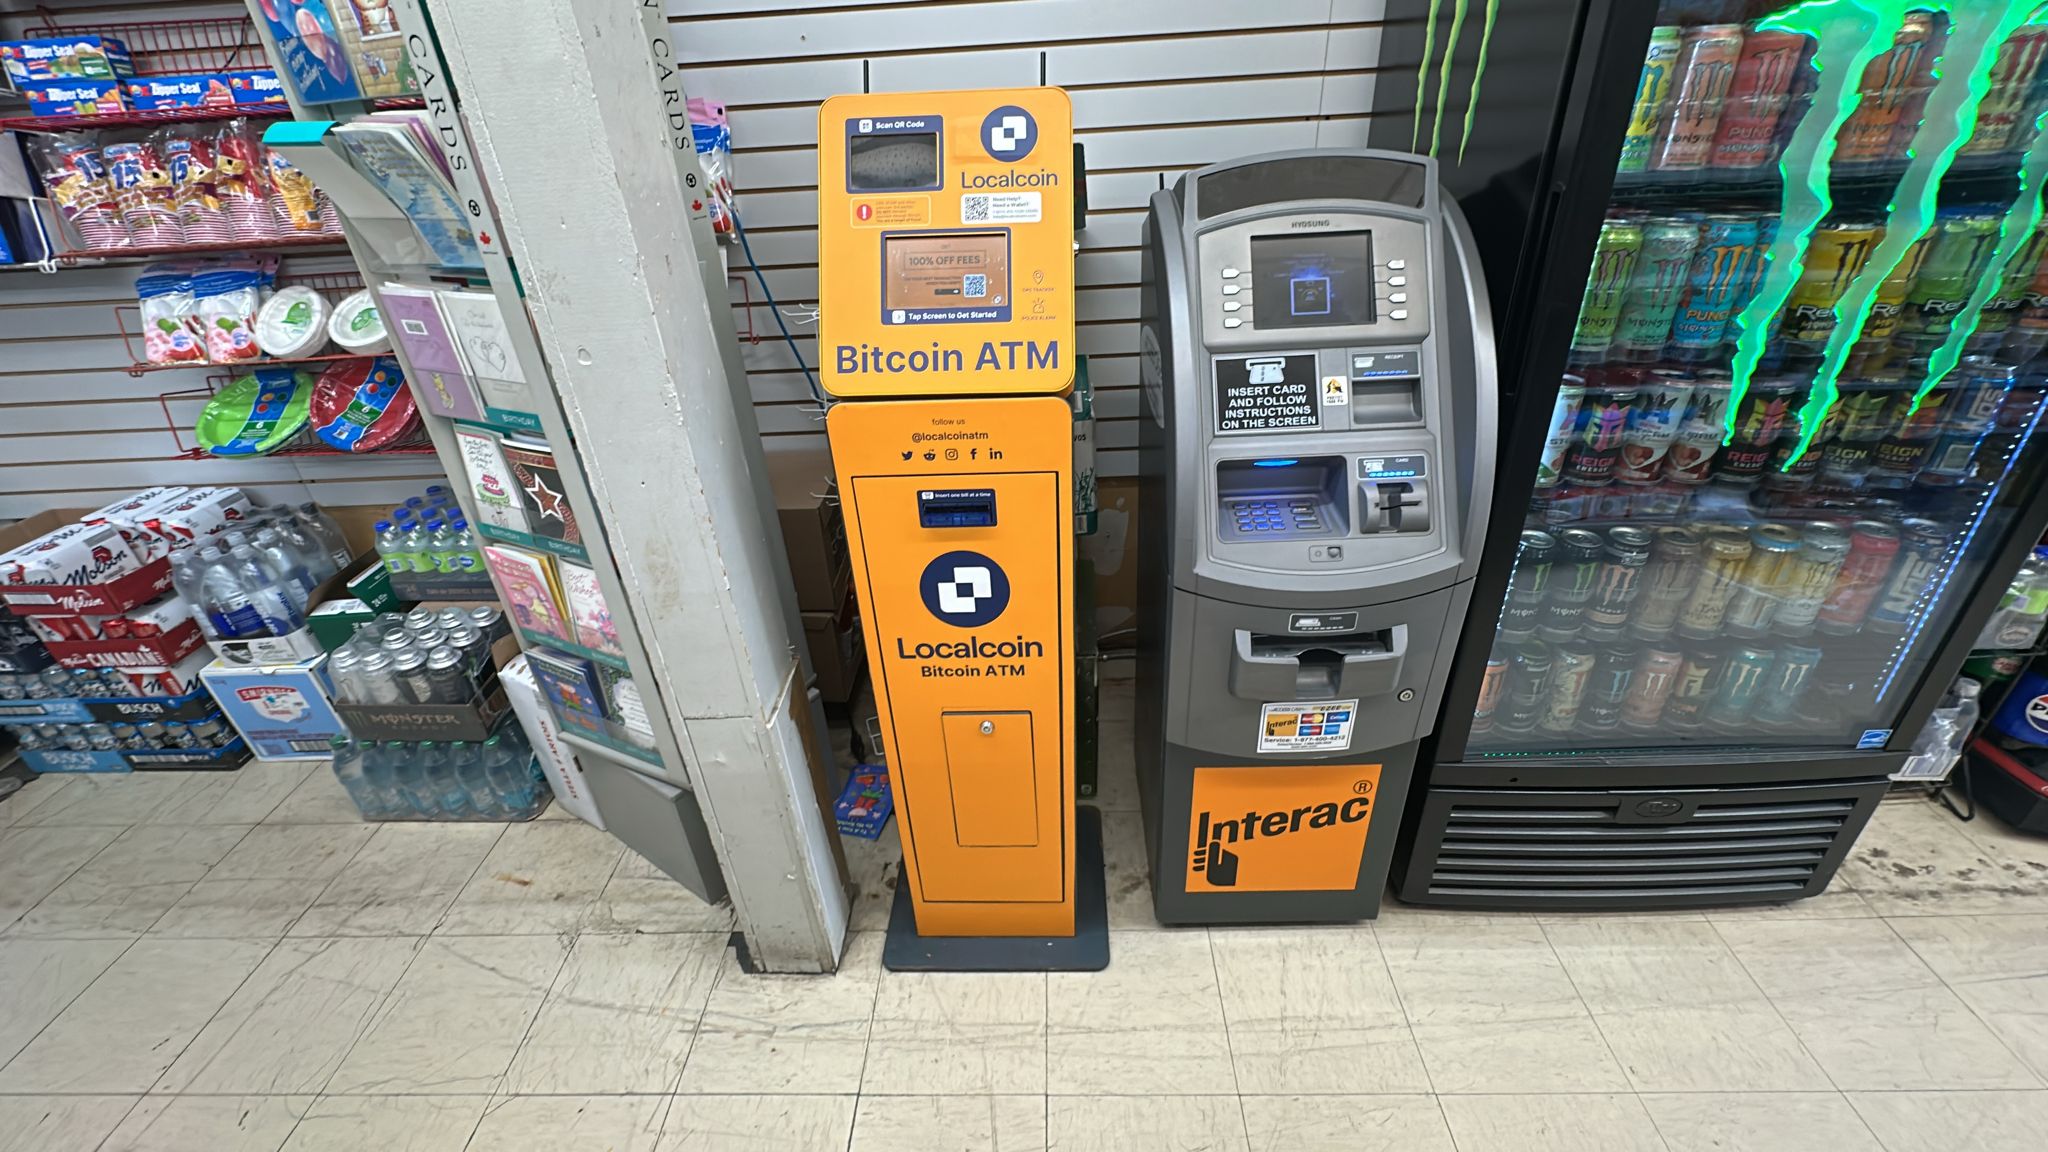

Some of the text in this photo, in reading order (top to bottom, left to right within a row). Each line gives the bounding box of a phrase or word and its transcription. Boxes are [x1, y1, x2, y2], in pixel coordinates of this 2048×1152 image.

[180, 82, 201, 95] Seal
[652, 38, 690, 150] CARDS
[409, 34, 467, 172] CARDS
[876, 120, 925, 129] Scan QR Code
[75, 151, 106, 183] 15
[169, 153, 191, 185] 15
[110, 157, 143, 191] 15
[961, 168, 1058, 189] Localcoin
[1291, 219, 1330, 228] HYOSUNG
[909, 255, 980, 266] 100% OFF FEES
[909, 311, 997, 321] Tap Screen to Get Started
[836, 340, 1059, 374] Bitcoin ATM
[1228, 384, 1306, 397] INSERT CARD
[1229, 395, 1307, 407] AND FOLLOW
[1225, 405, 1311, 419] INSTRUCTIONS
[932, 418, 954, 426] follow
[1222, 416, 1316, 429] ON THE SCREEN
[912, 431, 989, 443] @localcoinatm
[57, 589, 105, 611] Molson
[897, 635, 1043, 660] Localcoin
[86, 652, 158, 668] CANADIAN
[921, 664, 1026, 677] Bitcoin ATM
[117, 703, 164, 715] BUSCH
[370, 713, 461, 725] MONSTER
[1267, 718, 1297, 732] Interac
[41, 752, 97, 765] BUSCH
[1197, 796, 1370, 849] Interac
